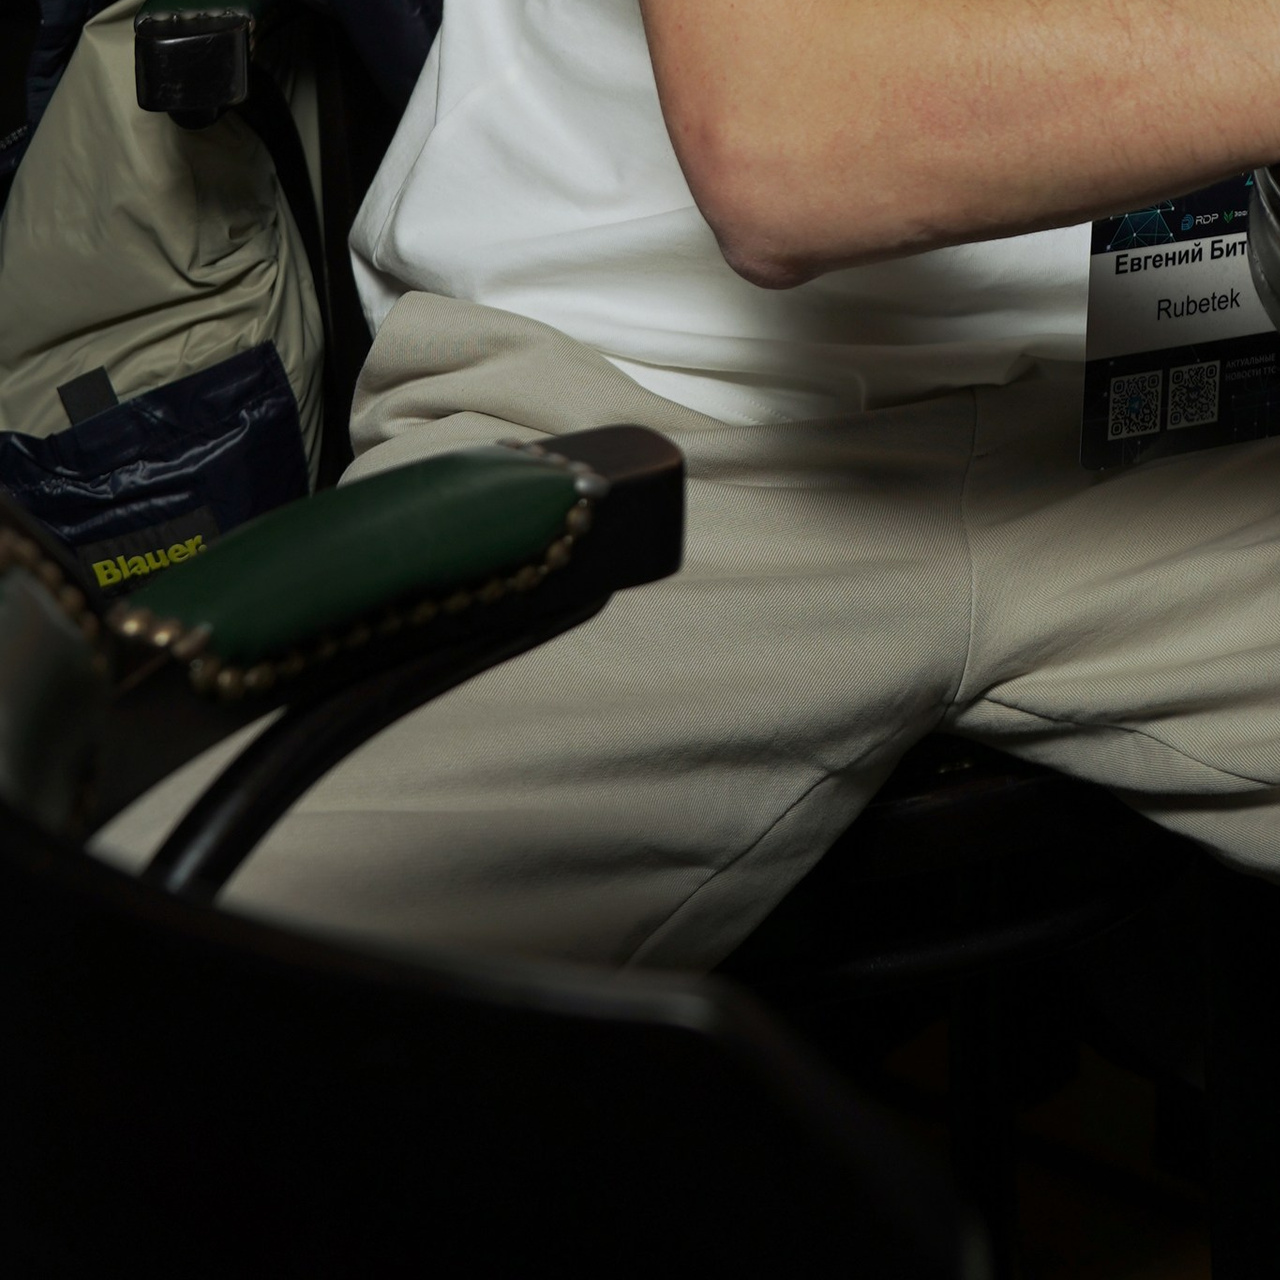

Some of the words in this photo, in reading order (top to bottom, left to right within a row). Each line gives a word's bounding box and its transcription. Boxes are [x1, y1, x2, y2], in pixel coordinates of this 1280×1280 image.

[1195, 213, 1219, 225] RDP
[1115, 243, 1203, 275] Евгений
[1157, 289, 1241, 320] Rubetek
[1226, 353, 1276, 368] АКТУАЛЬНЫЕ
[1225, 368, 1261, 381] НОВОСТИ
